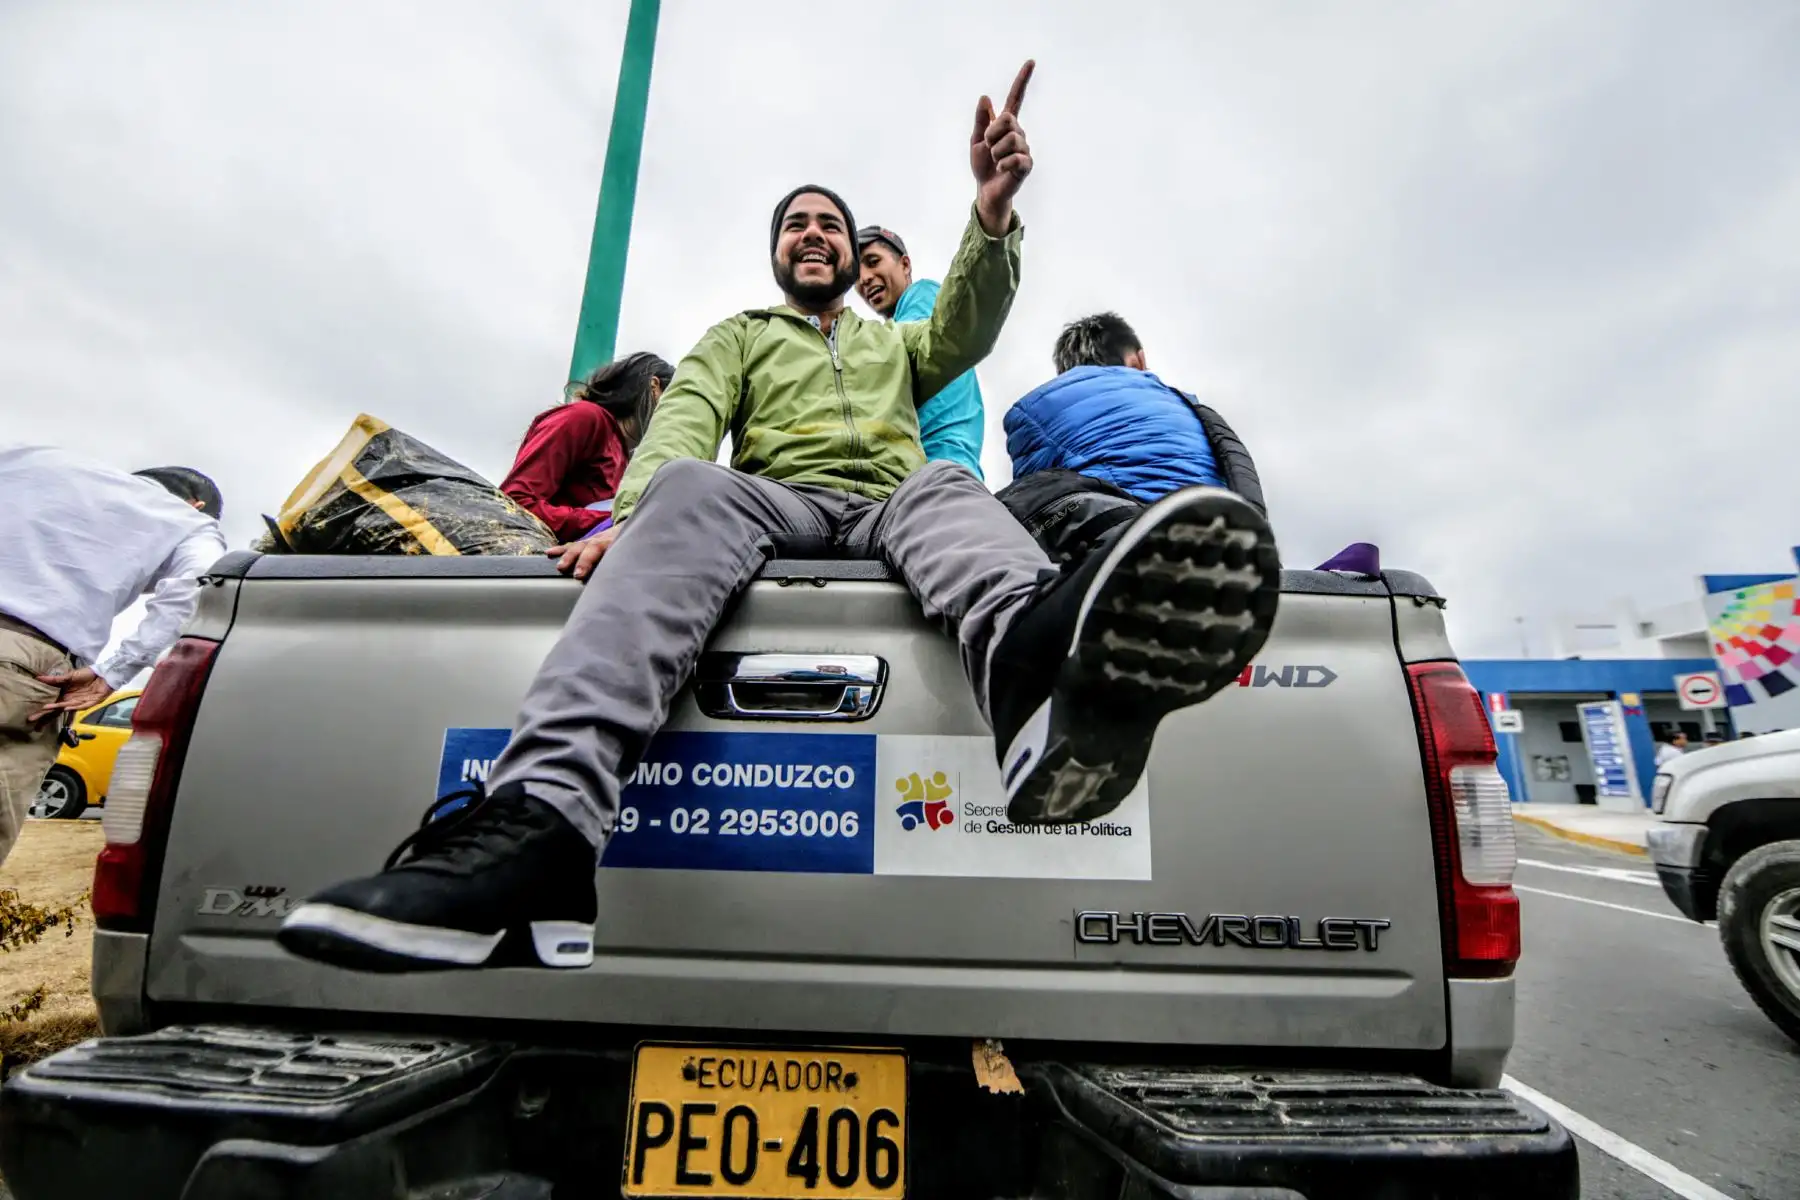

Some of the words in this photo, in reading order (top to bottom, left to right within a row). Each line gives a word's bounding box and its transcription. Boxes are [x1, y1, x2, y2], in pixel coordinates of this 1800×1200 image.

[691, 763, 855, 789] CONDUZCO
[670, 808, 710, 835] 02
[718, 808, 859, 838] 2953006
[963, 802, 1009, 818] Secret
[963, 820, 982, 834] de
[1080, 821, 1132, 837] Política
[1075, 910, 1391, 952] CHEVROLET
[697, 1056, 845, 1092] ECUADOR
